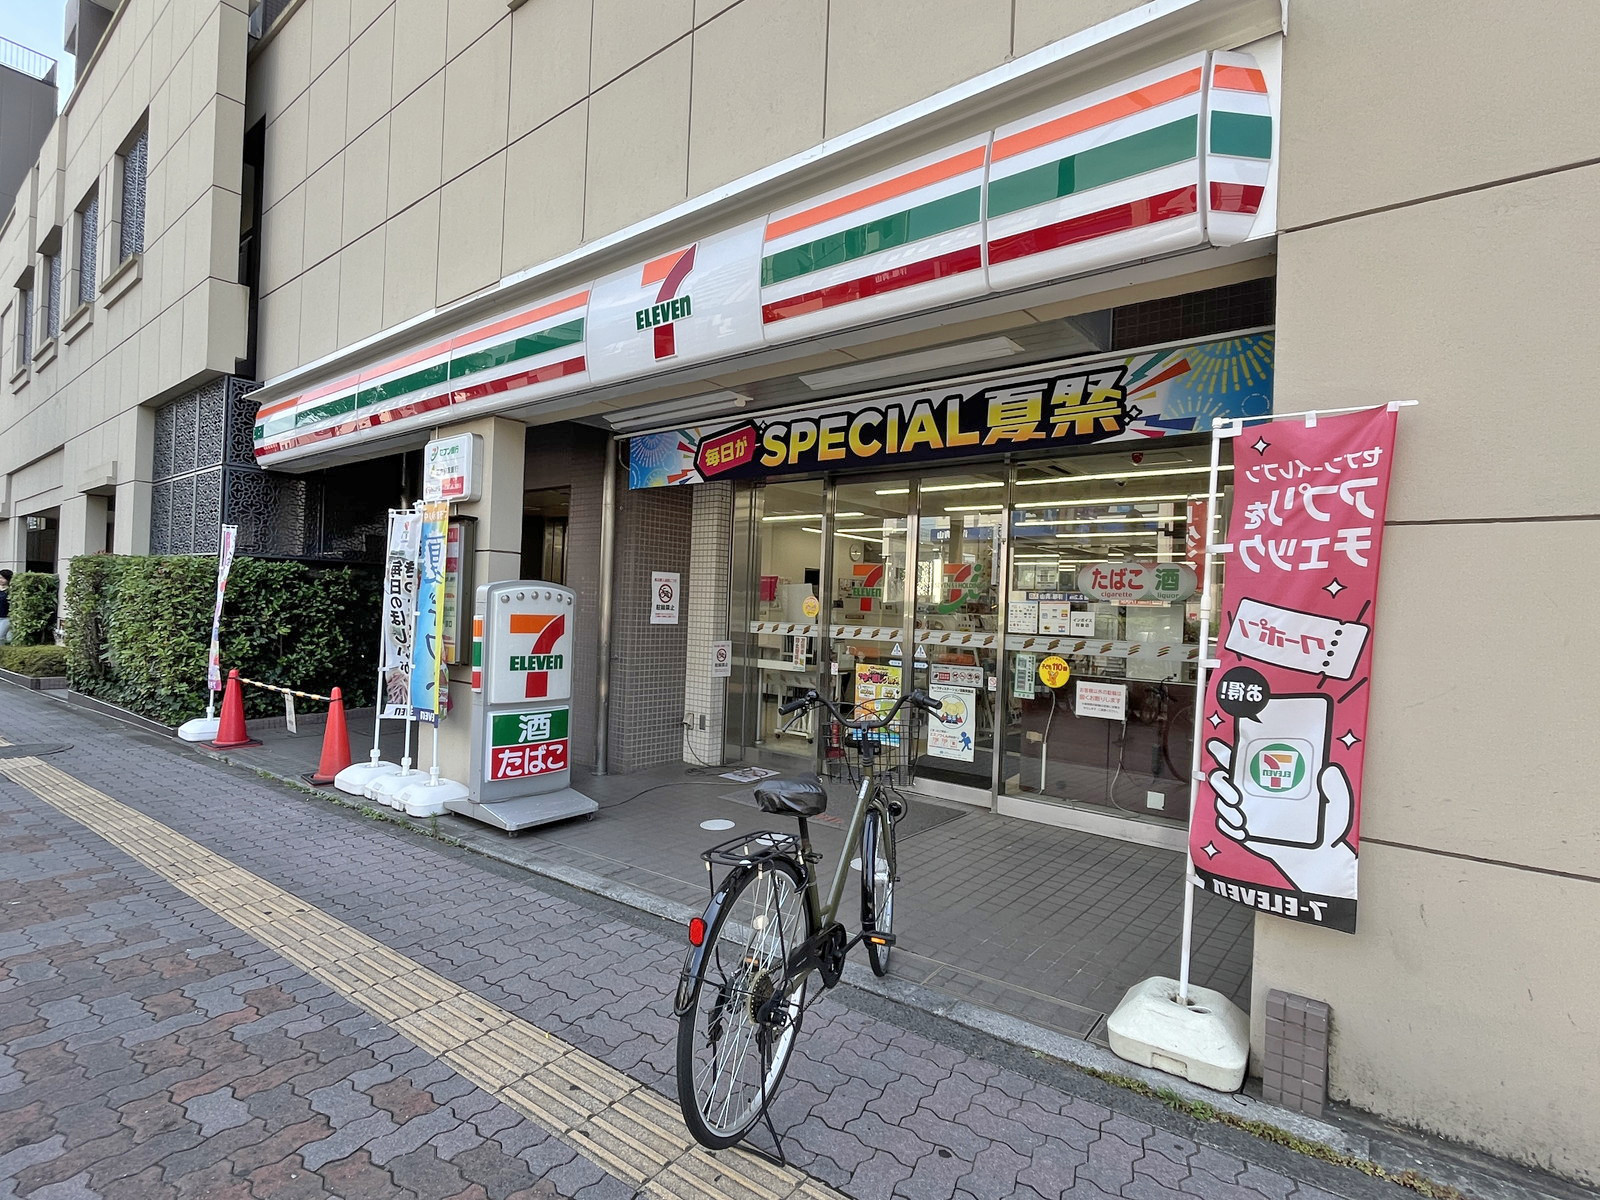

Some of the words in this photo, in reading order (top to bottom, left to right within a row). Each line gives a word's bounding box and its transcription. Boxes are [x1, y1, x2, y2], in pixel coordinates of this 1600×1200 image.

[705, 437, 748, 467] 毎日が
[760, 398, 980, 467] SPECIAL
[982, 369, 1122, 446] 夏祭
[1091, 568, 1144, 590] たばこ
[1155, 568, 1179, 591] 酒
[518, 714, 551, 743] 酒
[498, 745, 564, 778] たばこ
